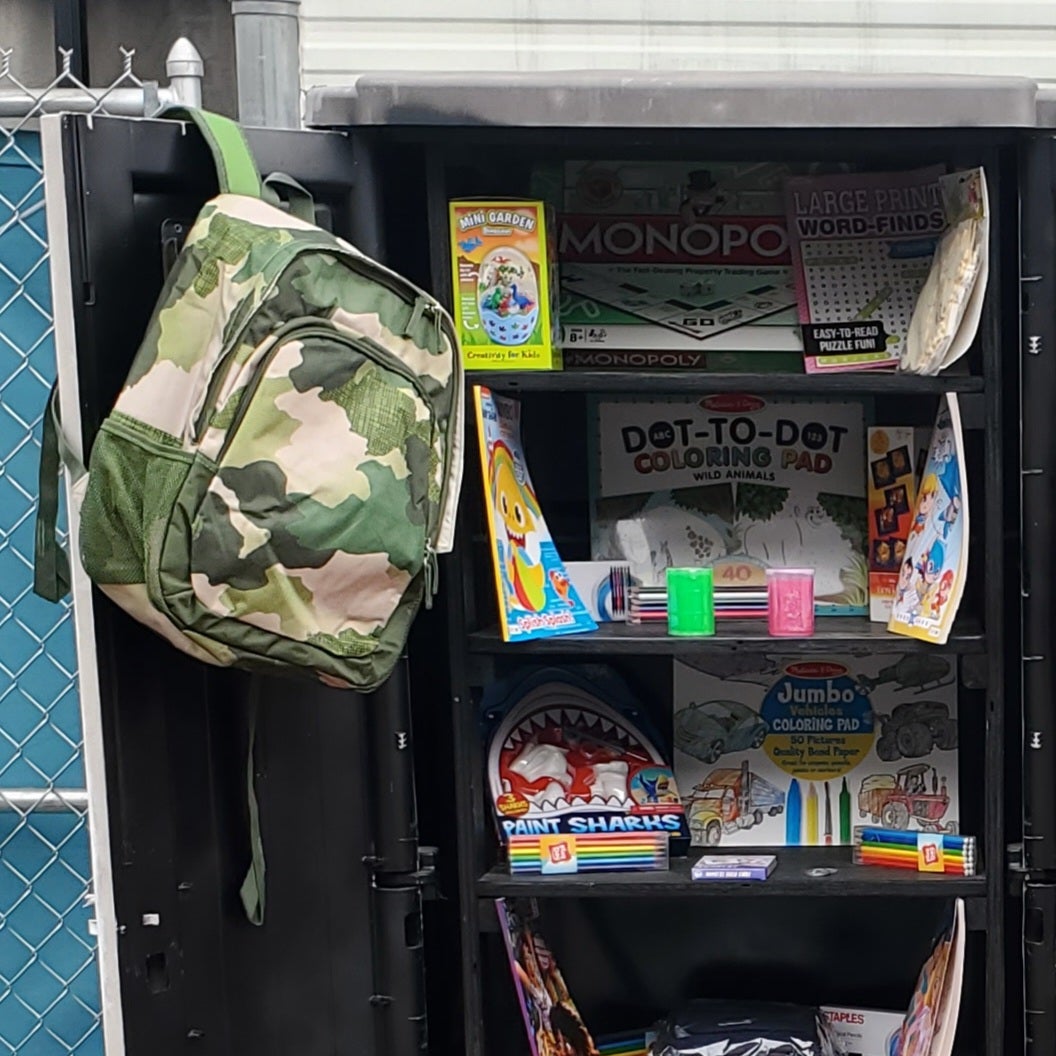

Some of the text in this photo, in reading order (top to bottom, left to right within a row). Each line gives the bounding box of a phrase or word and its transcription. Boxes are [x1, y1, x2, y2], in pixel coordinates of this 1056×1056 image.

[796, 184, 943, 215] LARGE PRINT
[488, 210, 536, 231] GARDEN
[799, 212, 945, 236] WORD-FINDS
[558, 222, 790, 257] MONOPO
[813, 326, 878, 341] EASY-TO-READ
[819, 338, 876, 352] PUZZLE FUN!
[573, 353, 702, 367] MONOPOLY
[621, 417, 849, 454] DOT-TO-DOT
[634, 446, 833, 475] COLORING PAD
[694, 468, 776, 481] WILD ANIMALS
[722, 566, 751, 580] 40
[777, 679, 856, 705] Jumbo
[790, 704, 844, 717] Vehicles
[836, 718, 860, 731] PAD
[502, 813, 682, 836] PAINT SHARKS
[825, 1012, 865, 1025] STAPLES
